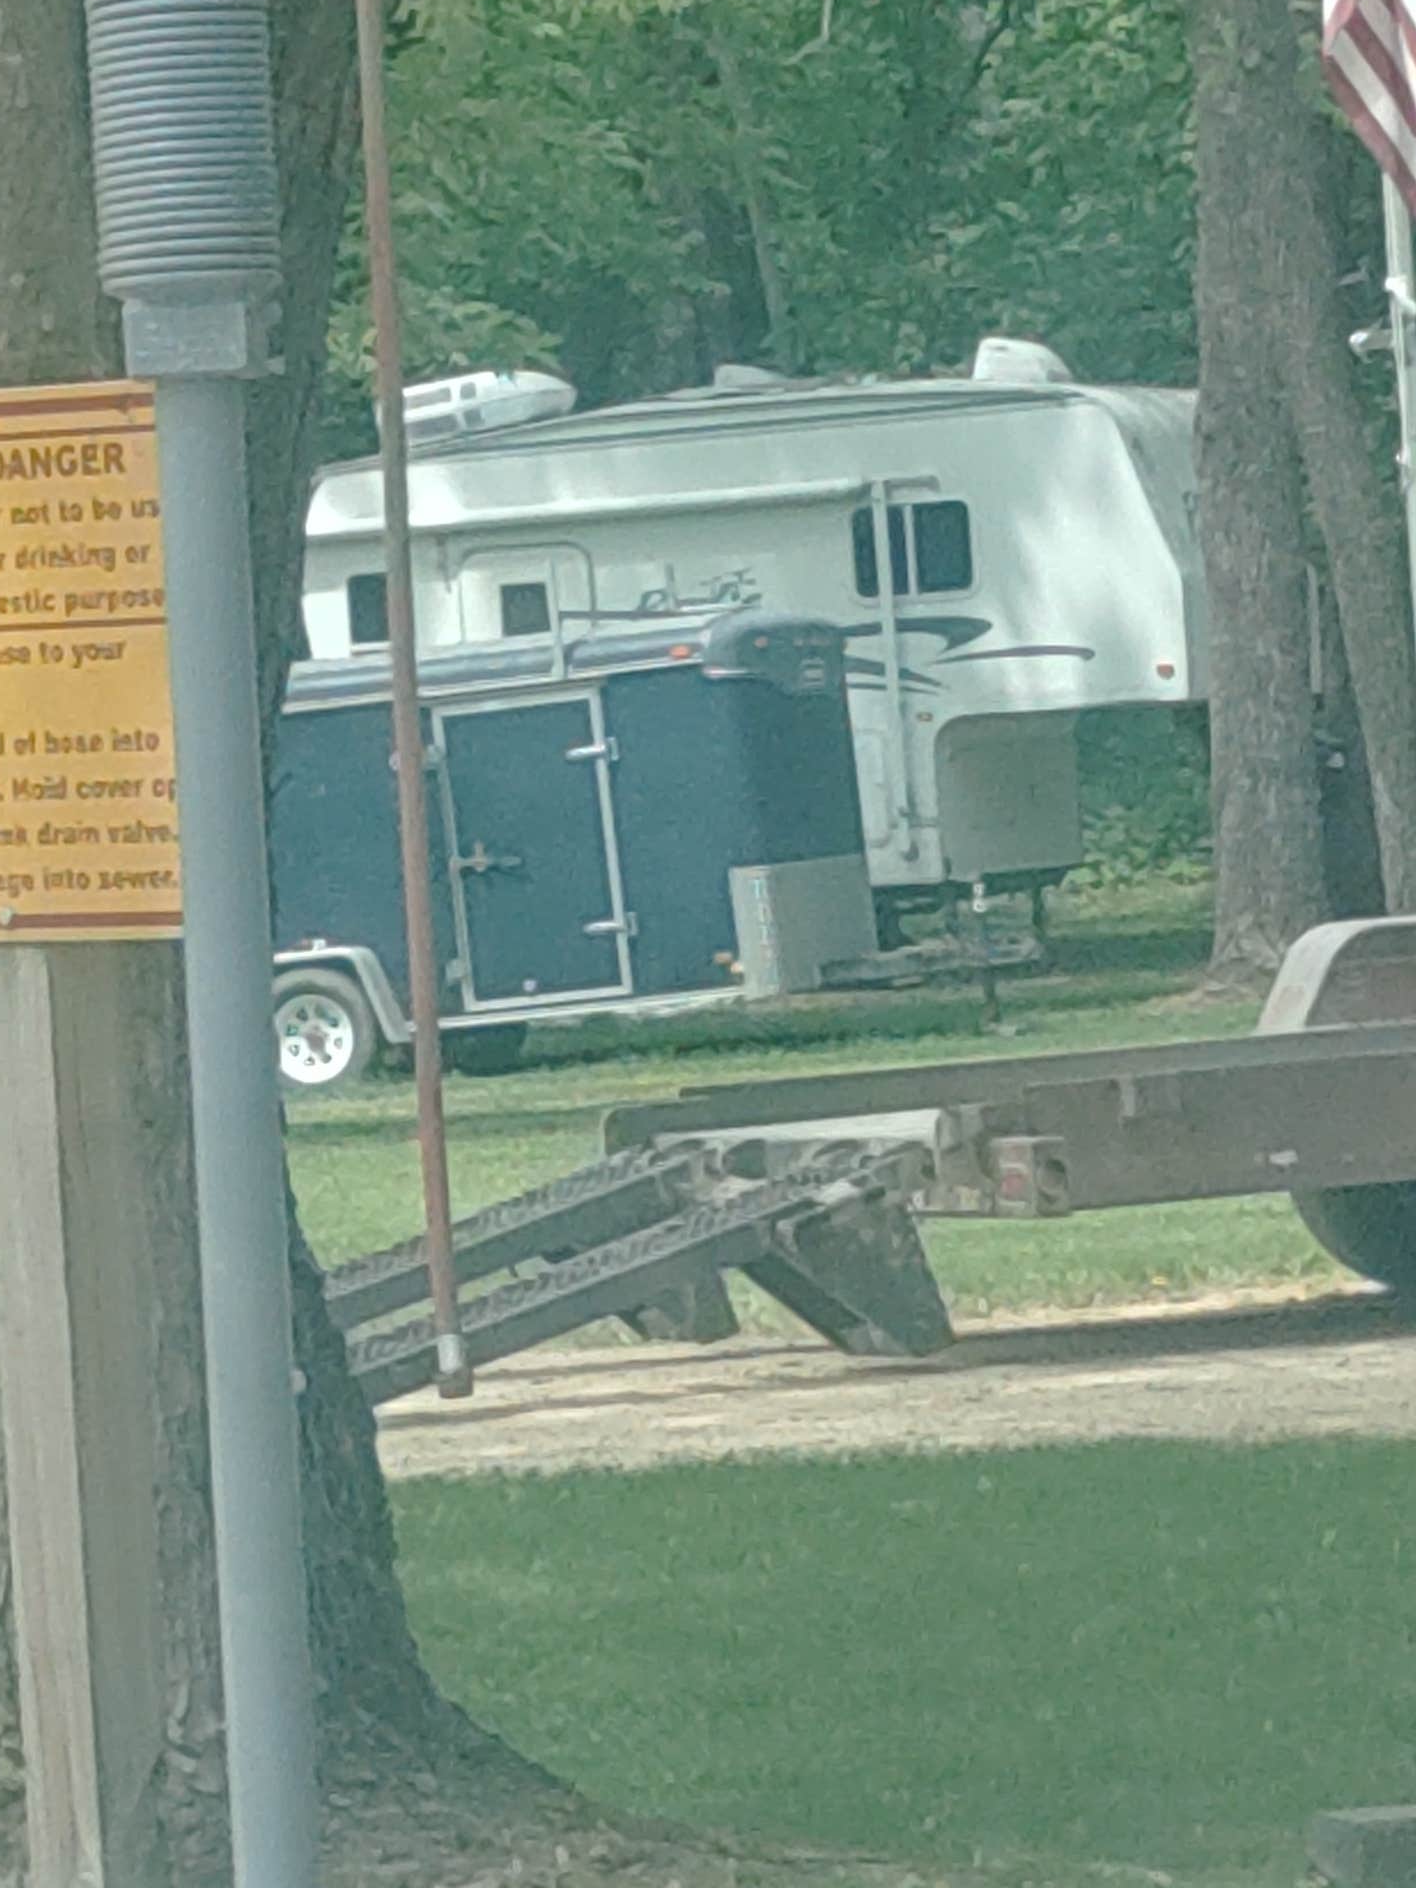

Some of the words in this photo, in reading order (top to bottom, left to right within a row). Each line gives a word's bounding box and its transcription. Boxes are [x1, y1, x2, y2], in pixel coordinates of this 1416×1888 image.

[10, 503, 50, 525] not
[59, 499, 83, 523] to
[92, 496, 122, 521] be
[131, 498, 161, 518] us
[15, 542, 116, 573] drinking
[124, 544, 151, 564] or
[64, 588, 165, 617] purpose
[39, 642, 64, 664] to
[72, 640, 127, 669] your
[14, 730, 36, 756] of
[45, 729, 104, 755] hose
[111, 727, 160, 753] into
[11, 776, 68, 801] Hold
[75, 778, 144, 800] cover
[37, 821, 100, 845] drain
[43, 867, 91, 891] into
